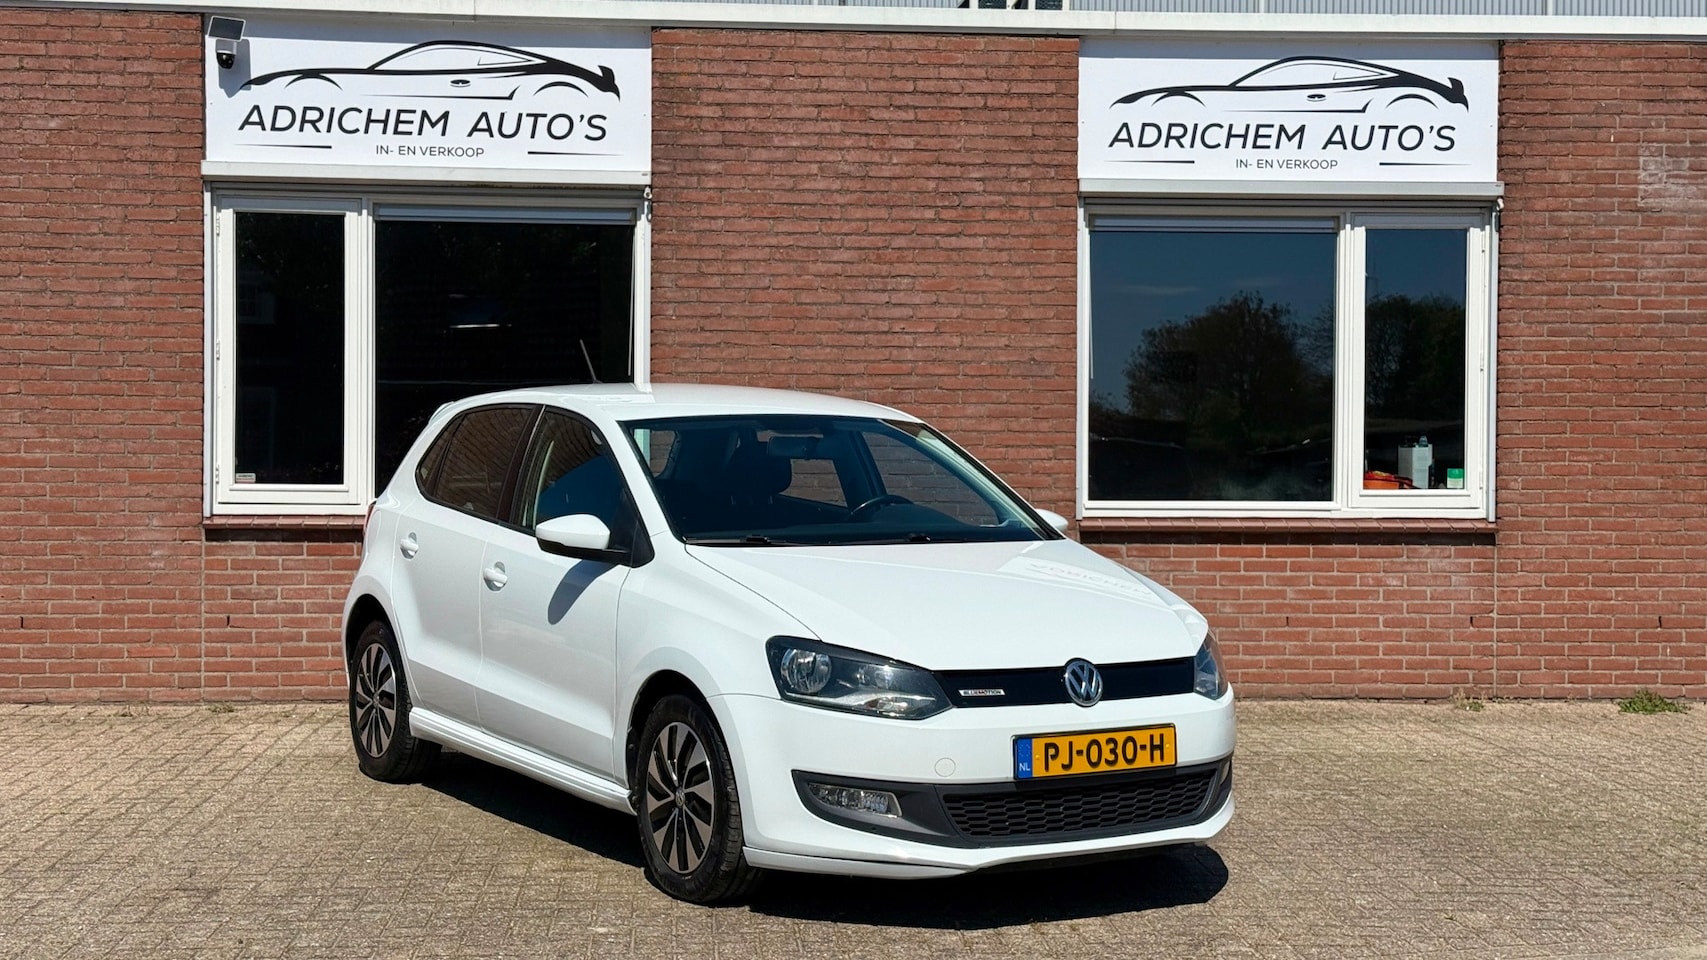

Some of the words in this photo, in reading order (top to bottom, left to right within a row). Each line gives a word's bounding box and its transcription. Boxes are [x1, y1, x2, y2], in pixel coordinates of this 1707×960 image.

[238, 104, 450, 137] ADRICHEM
[466, 111, 608, 142] AUTO'S
[1108, 122, 1306, 151] ADRICHEM
[1321, 124, 1456, 152] AUTO'S
[375, 144, 395, 156] IN-
[398, 145, 416, 156] EN
[419, 146, 485, 158] VERKOOP
[1235, 158, 1253, 169] IN-
[1256, 159, 1274, 169] EN
[1276, 159, 1338, 170] VERKOOP
[1043, 733, 1166, 773] PJ-030-H
[1019, 762, 1031, 772] NL
